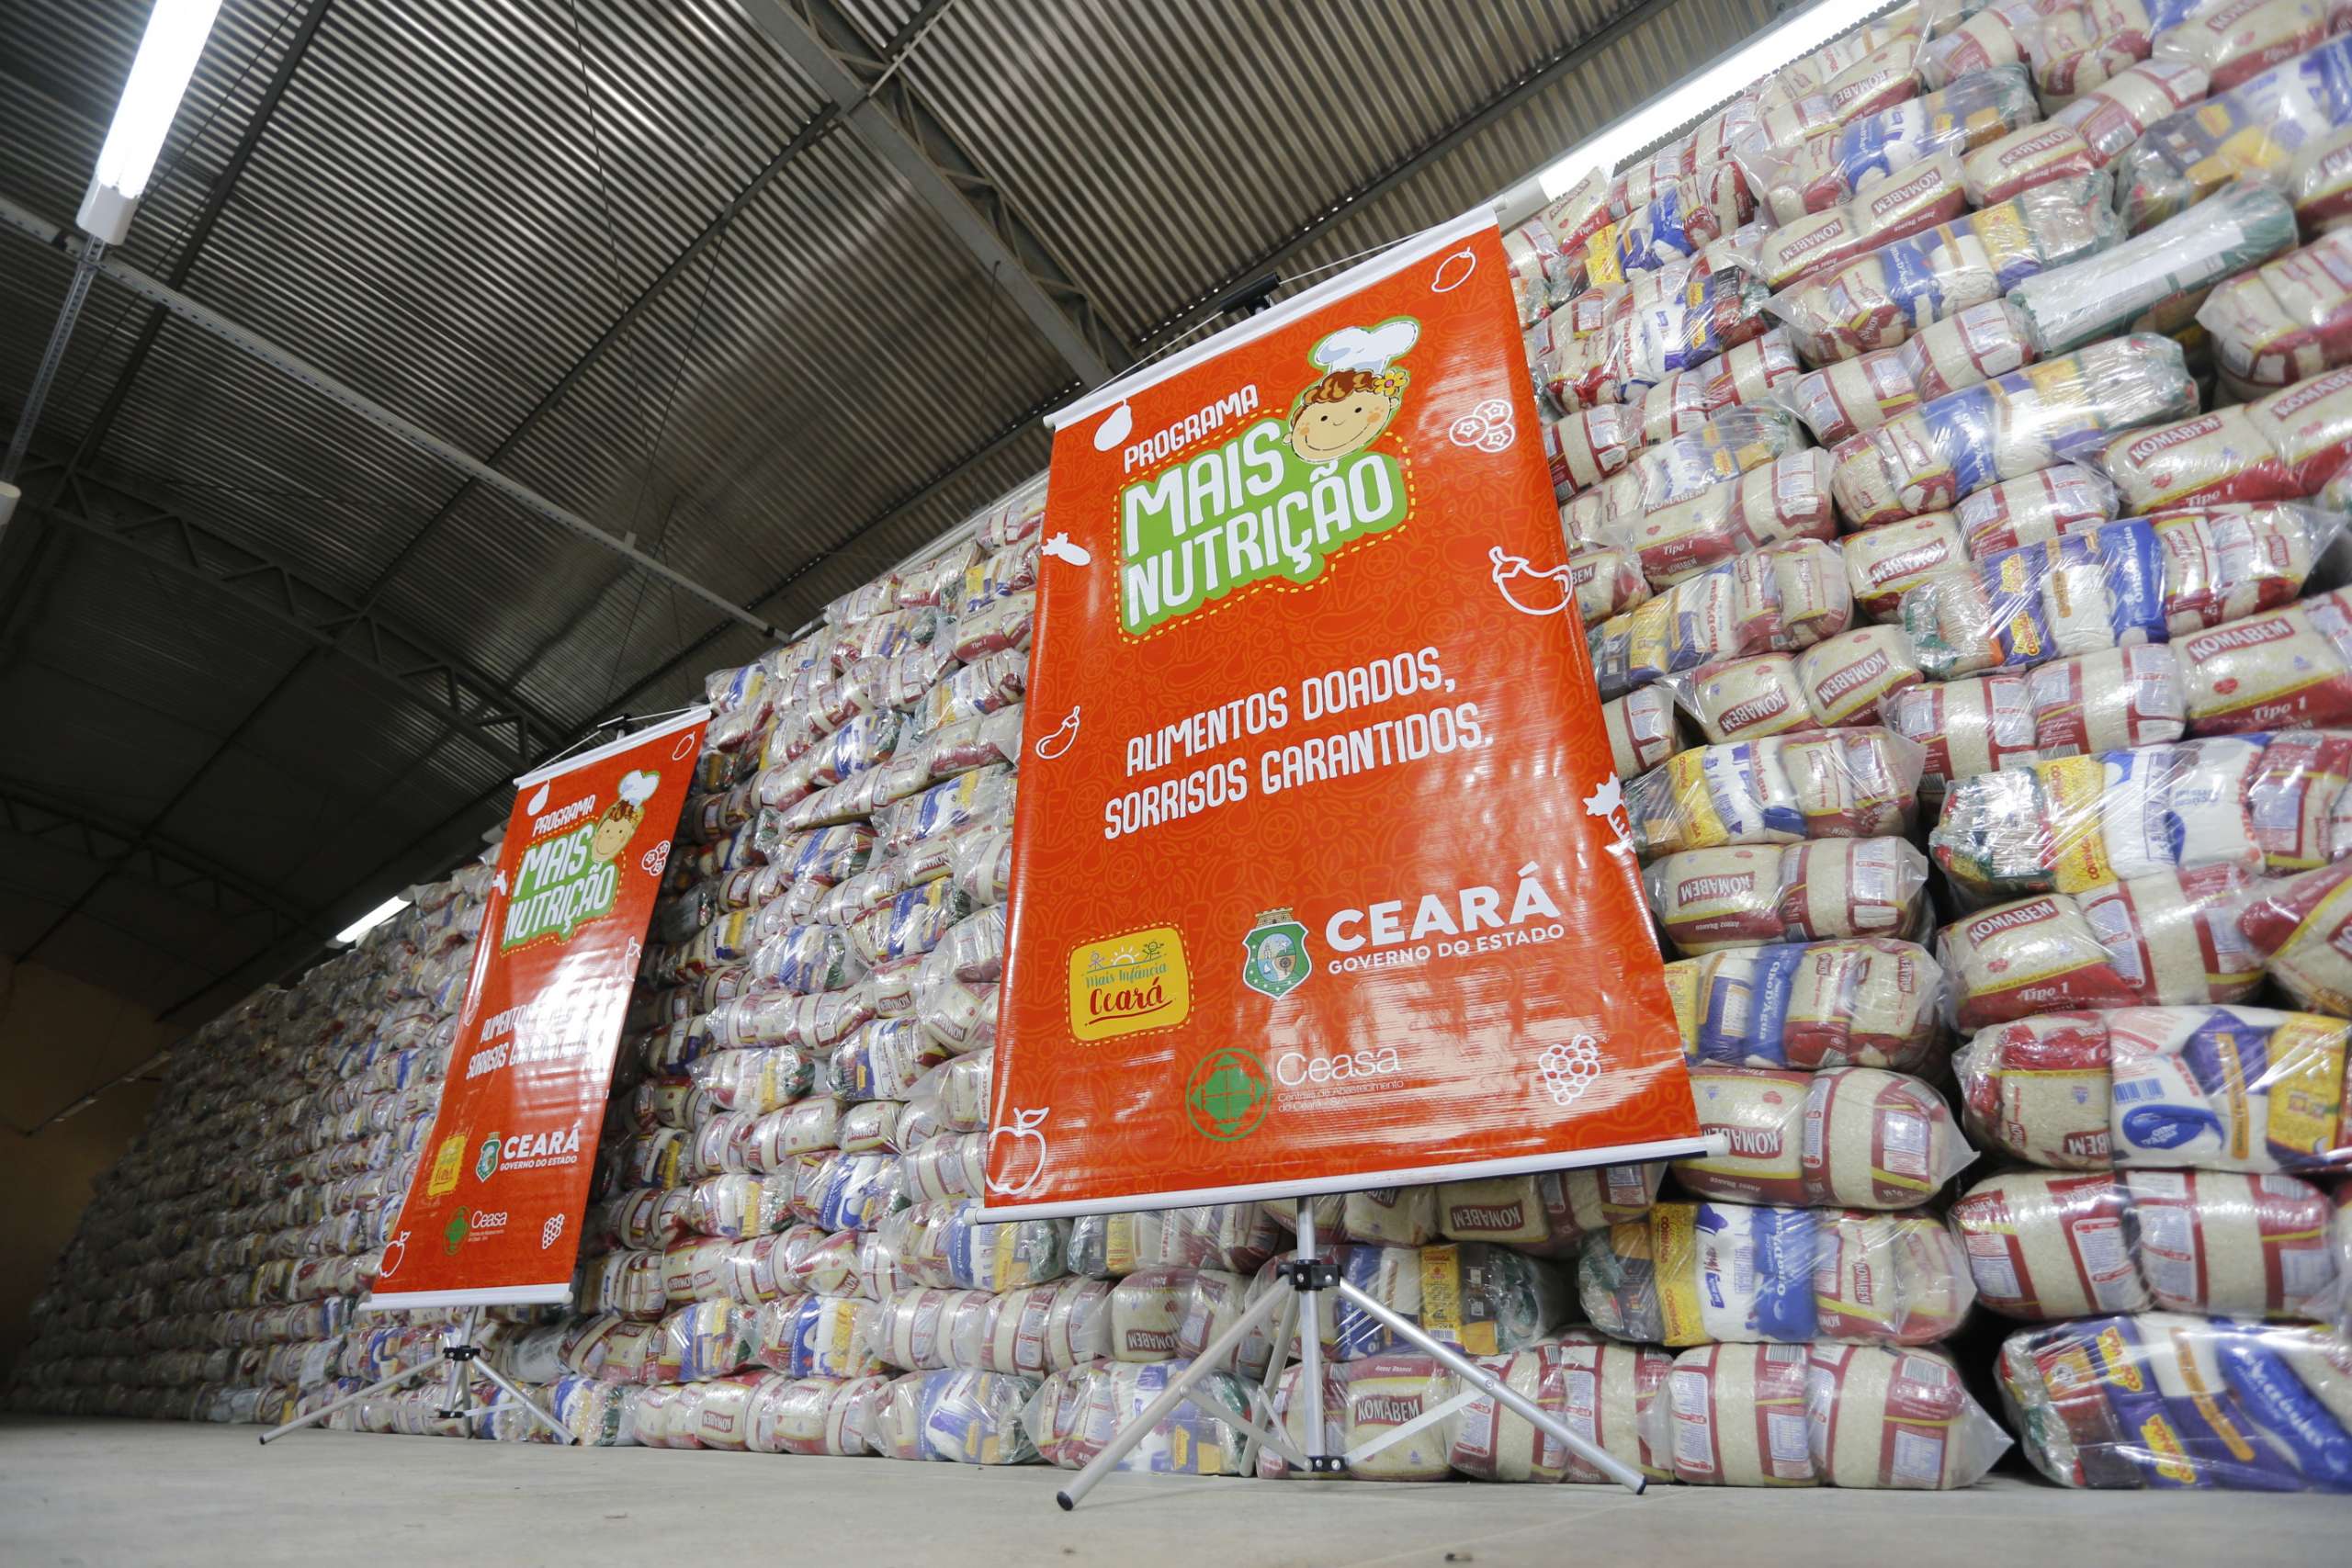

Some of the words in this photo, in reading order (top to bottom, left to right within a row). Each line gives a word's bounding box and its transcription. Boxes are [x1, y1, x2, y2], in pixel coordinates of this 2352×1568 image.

[1836, 70, 1888, 105] KOMABE
[1872, 168, 1940, 213] KOMABEM
[1781, 219, 1842, 262] KOMABEM
[1124, 384, 1259, 473] PROGRAMA
[2130, 416, 2221, 460] KOMABEM
[1125, 422, 1284, 557] MAIS
[2185, 490, 2221, 508] Tipo
[1127, 454, 1394, 626] NUTRIÇÃO
[1662, 541, 1685, 556] Tipo
[2188, 620, 2291, 660] KOMABEM
[1818, 652, 1888, 703] KOMABEM
[1126, 686, 1288, 777] ALIMENTOS
[1303, 647, 1456, 722] DOADOS,
[1721, 690, 1787, 732] KOMABEM
[2252, 703, 2291, 721] Tipo
[2299, 695, 2307, 710] 1
[533, 795, 595, 837] PROGRAMA
[1103, 761, 1249, 840] SORRISOS
[514, 824, 594, 897] MAIS
[503, 861, 615, 945] NUTRIÇÃO
[1326, 861, 1561, 952] CEARÁ
[1680, 874, 1755, 901] KOMABEM
[1969, 901, 2054, 942] KOMABEM
[1328, 947, 1431, 976] GOVERNO
[1436, 938, 1471, 958] DO
[1475, 924, 1565, 954] ESTADO
[1086, 973, 1115, 988] Mais
[1118, 962, 1168, 984] Infância
[2021, 986, 2056, 1002] Tipo
[2061, 981, 2069, 994] 1
[1090, 976, 1167, 1015] Ceará
[1276, 1047, 1403, 1086] Ceasa
[503, 1119, 582, 1159] CEARÁ
[500, 1160, 534, 1171] GOVERNO
[536, 1158, 546, 1168] DO
[548, 1156, 577, 1167] ESTADO
[471, 1211, 507, 1228] Ceasa
[1453, 1207, 1521, 1228] KOMABEM
[1128, 1332, 1175, 1351] OMABEM
[1357, 1398, 1419, 1422] KOMABEM
